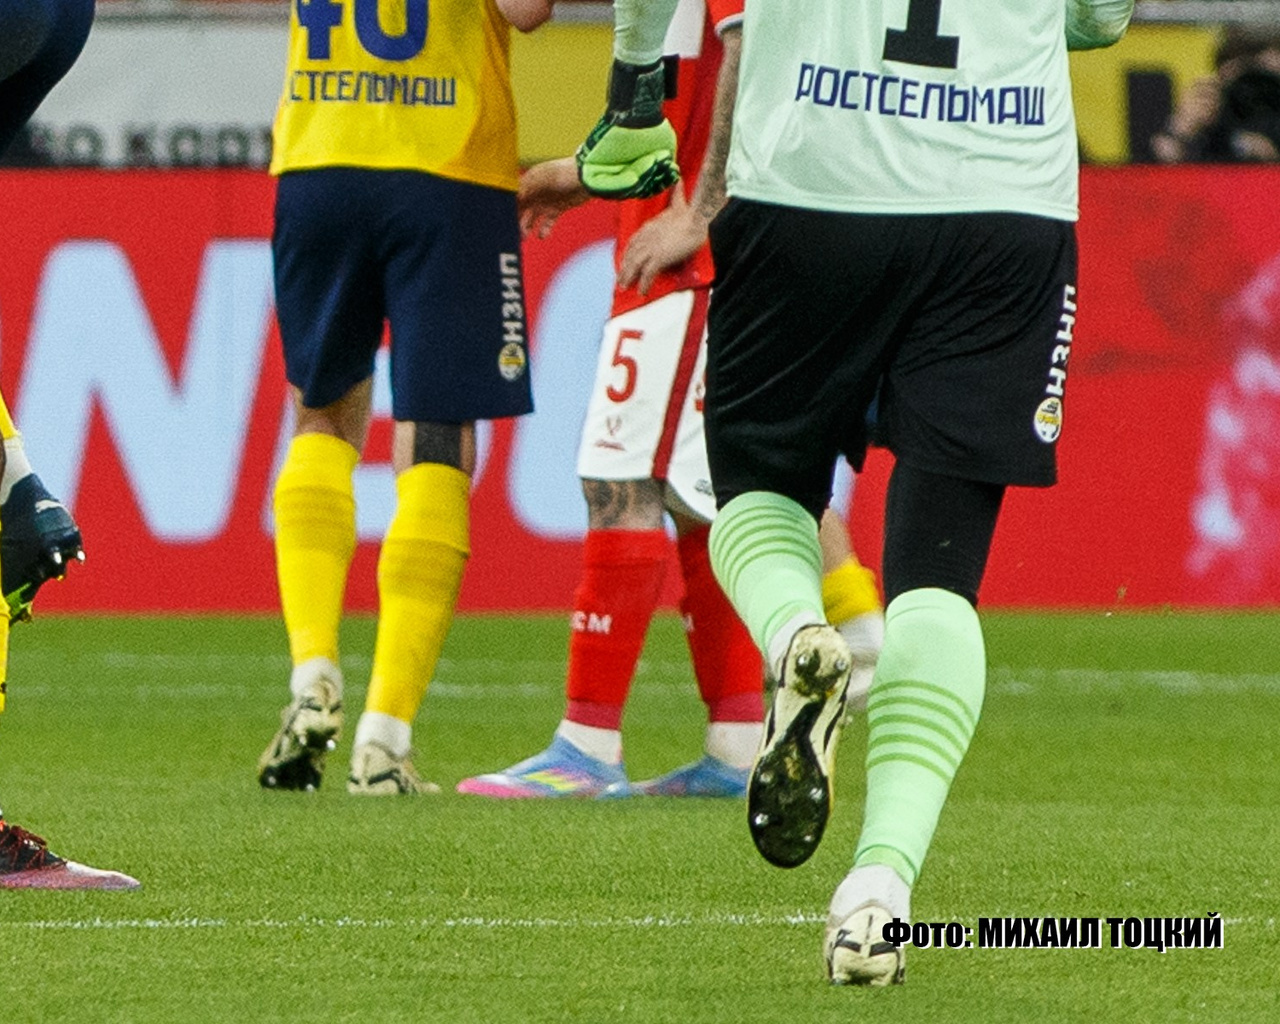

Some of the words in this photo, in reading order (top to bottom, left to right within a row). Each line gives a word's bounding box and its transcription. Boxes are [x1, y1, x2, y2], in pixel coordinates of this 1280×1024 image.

[290, 70, 457, 106] СТСЕЛЬМАШ
[794, 62, 1046, 126] РОСТСЕЛЬМАШ
[499, 252, 524, 343] НЗНП
[606, 329, 645, 404] 5
[1045, 284, 1078, 397] НЗНП
